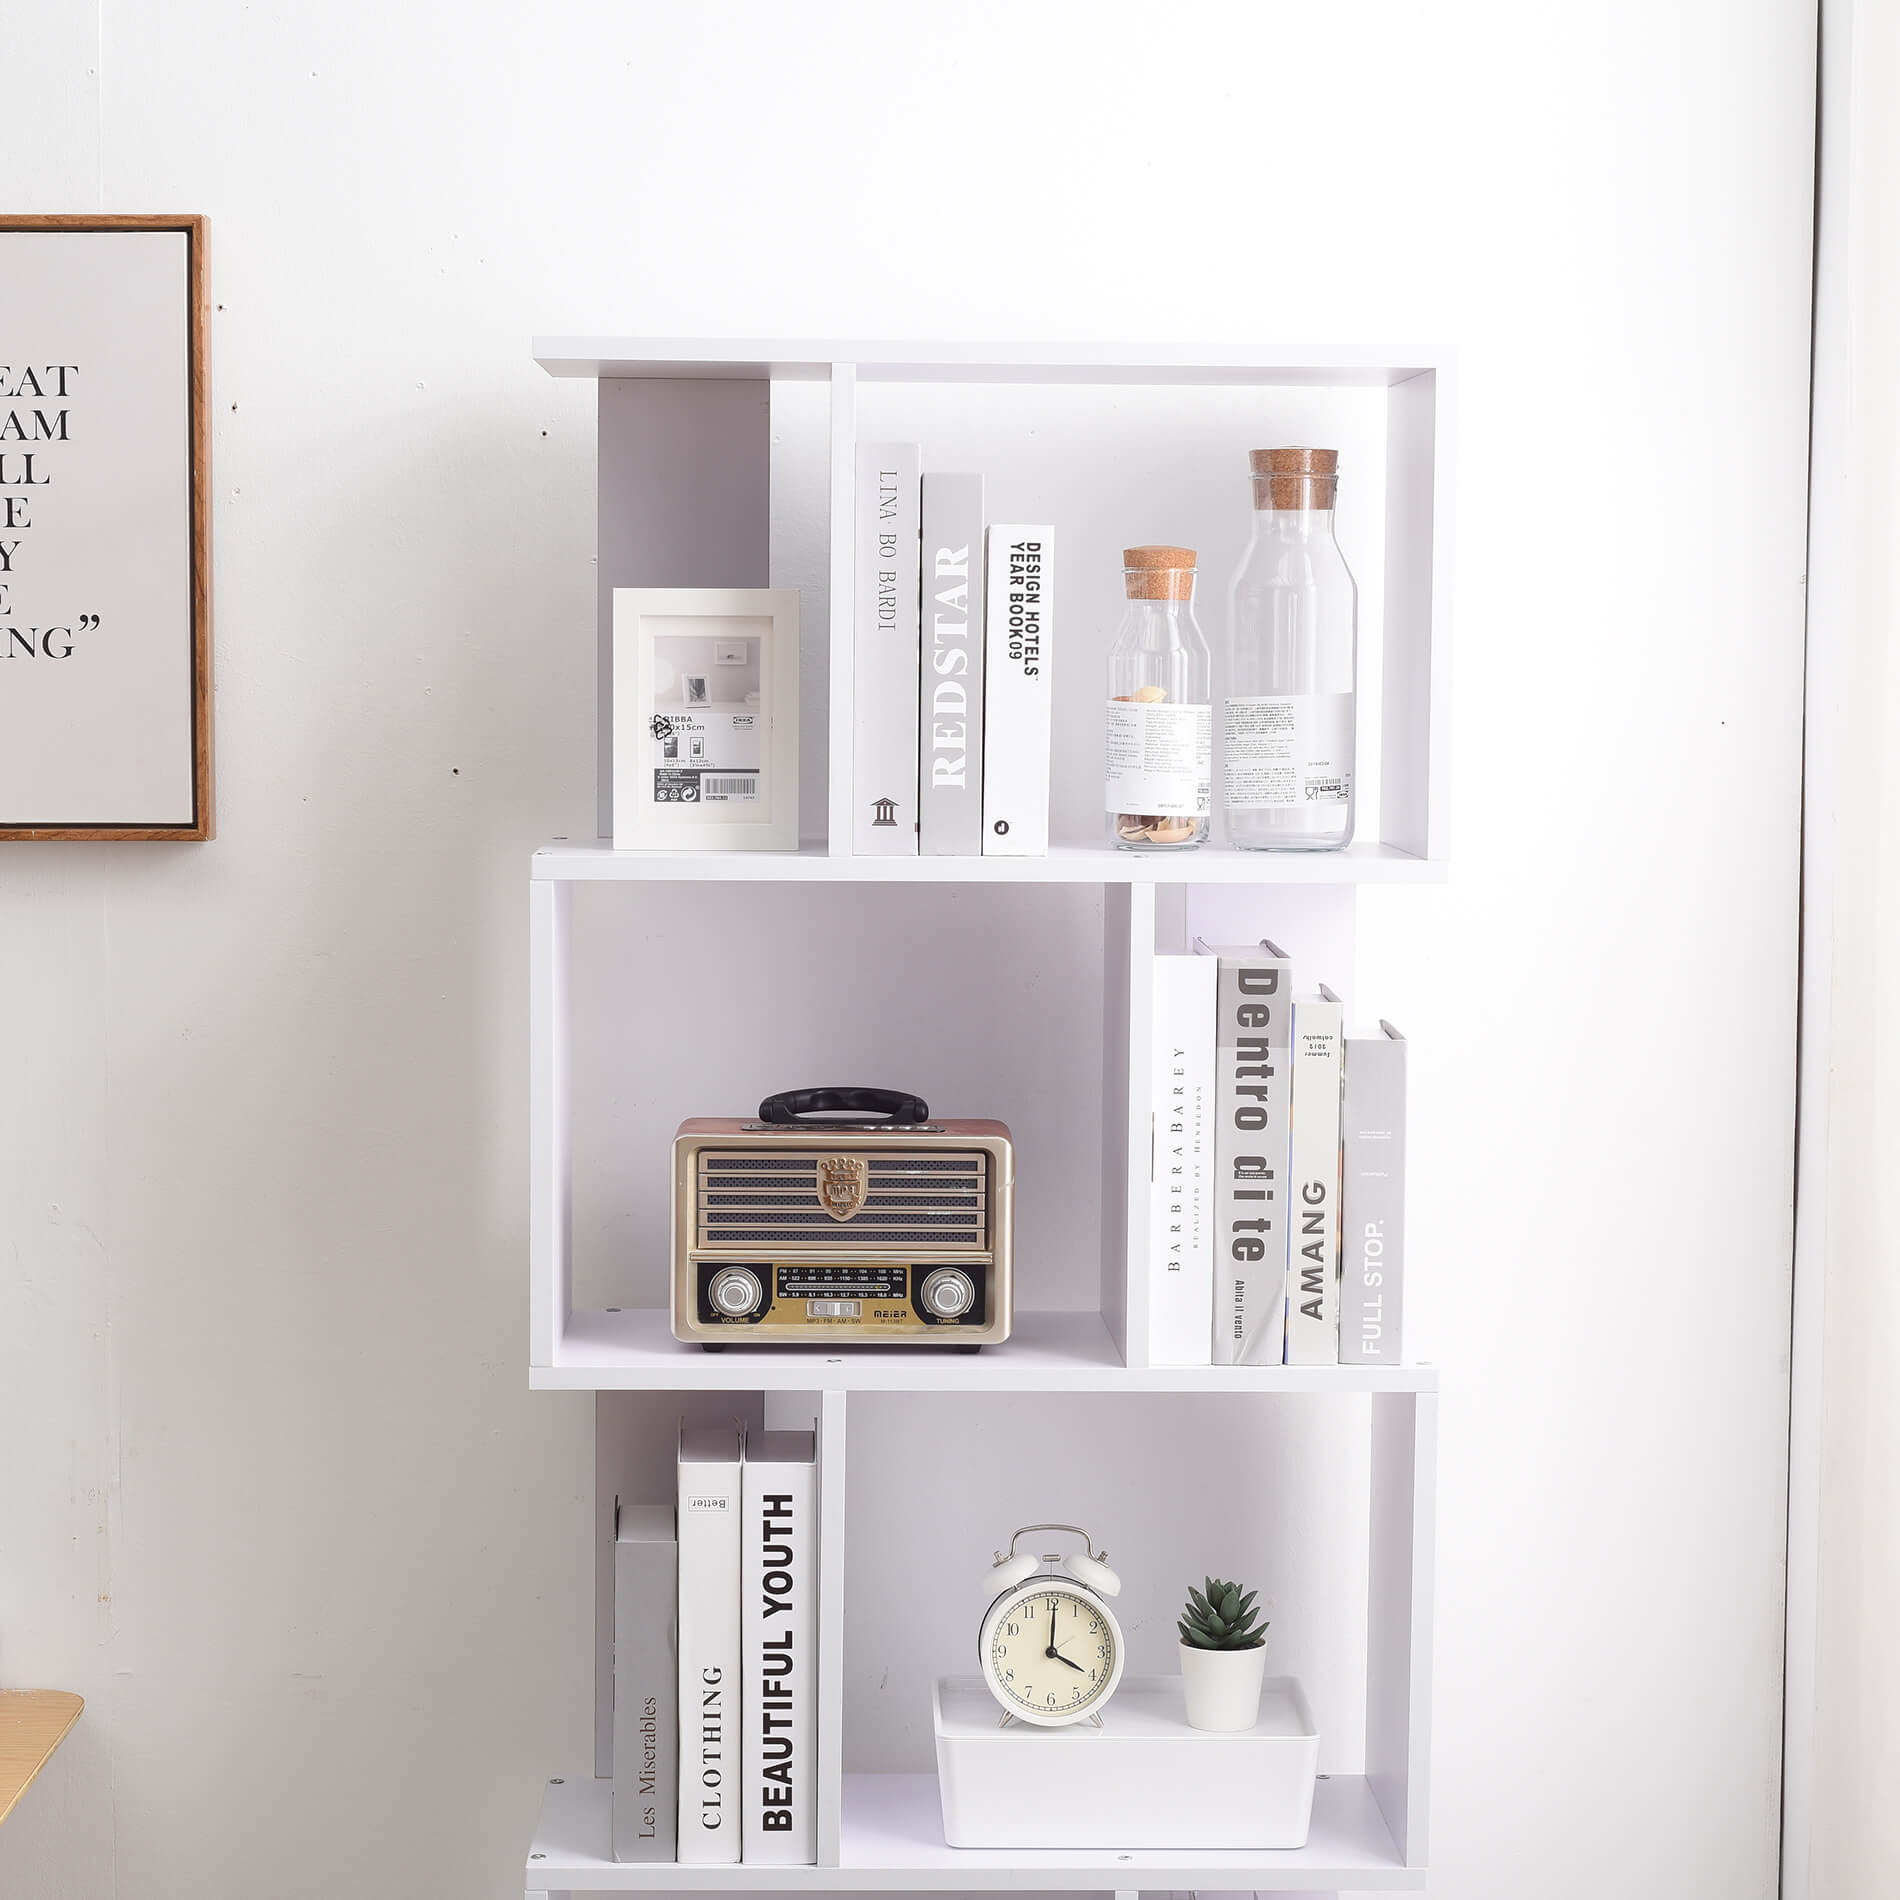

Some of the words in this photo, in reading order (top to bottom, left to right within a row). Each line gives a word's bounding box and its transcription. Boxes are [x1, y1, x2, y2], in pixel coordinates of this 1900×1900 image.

[880, 535, 896, 557] BO
[1010, 542, 1024, 585] YEAR
[1025, 541, 1041, 603] DESIGN
[879, 572, 896, 629] BARDI
[933, 544, 968, 789] REDSTAR
[1235, 969, 1278, 1130] Dentro
[1234, 1156, 1274, 1200] di
[1232, 1218, 1271, 1261] te
[1300, 1183, 1325, 1320] AMANG
[1364, 1220, 1383, 1286] STOP.
[1235, 1280, 1244, 1302] Abita
[1235, 1315, 1243, 1338] vento
[1362, 1294, 1382, 1354] FULL
[763, 1495, 793, 1618] YOUTH
[1024, 1606, 1034, 1619] 11
[1046, 1598, 1059, 1611] 12
[1073, 1605, 1078, 1618] 1
[1007, 1623, 1020, 1636] 10
[1089, 1622, 1098, 1634] 2
[998, 1645, 1007, 1658] 9
[1097, 1646, 1106, 1659] 3
[1006, 1669, 1014, 1681] 8
[1088, 1669, 1097, 1681] 4
[1025, 1686, 1033, 1698] 7
[1047, 1693, 1056, 1705] 6
[1072, 1687, 1080, 1700] 5
[763, 1631, 793, 1831] BEAUTIFUL
[640, 1698, 656, 1793] Miserables
[702, 1666, 722, 1830] CLOTHING
[639, 1808, 655, 1838] Les
